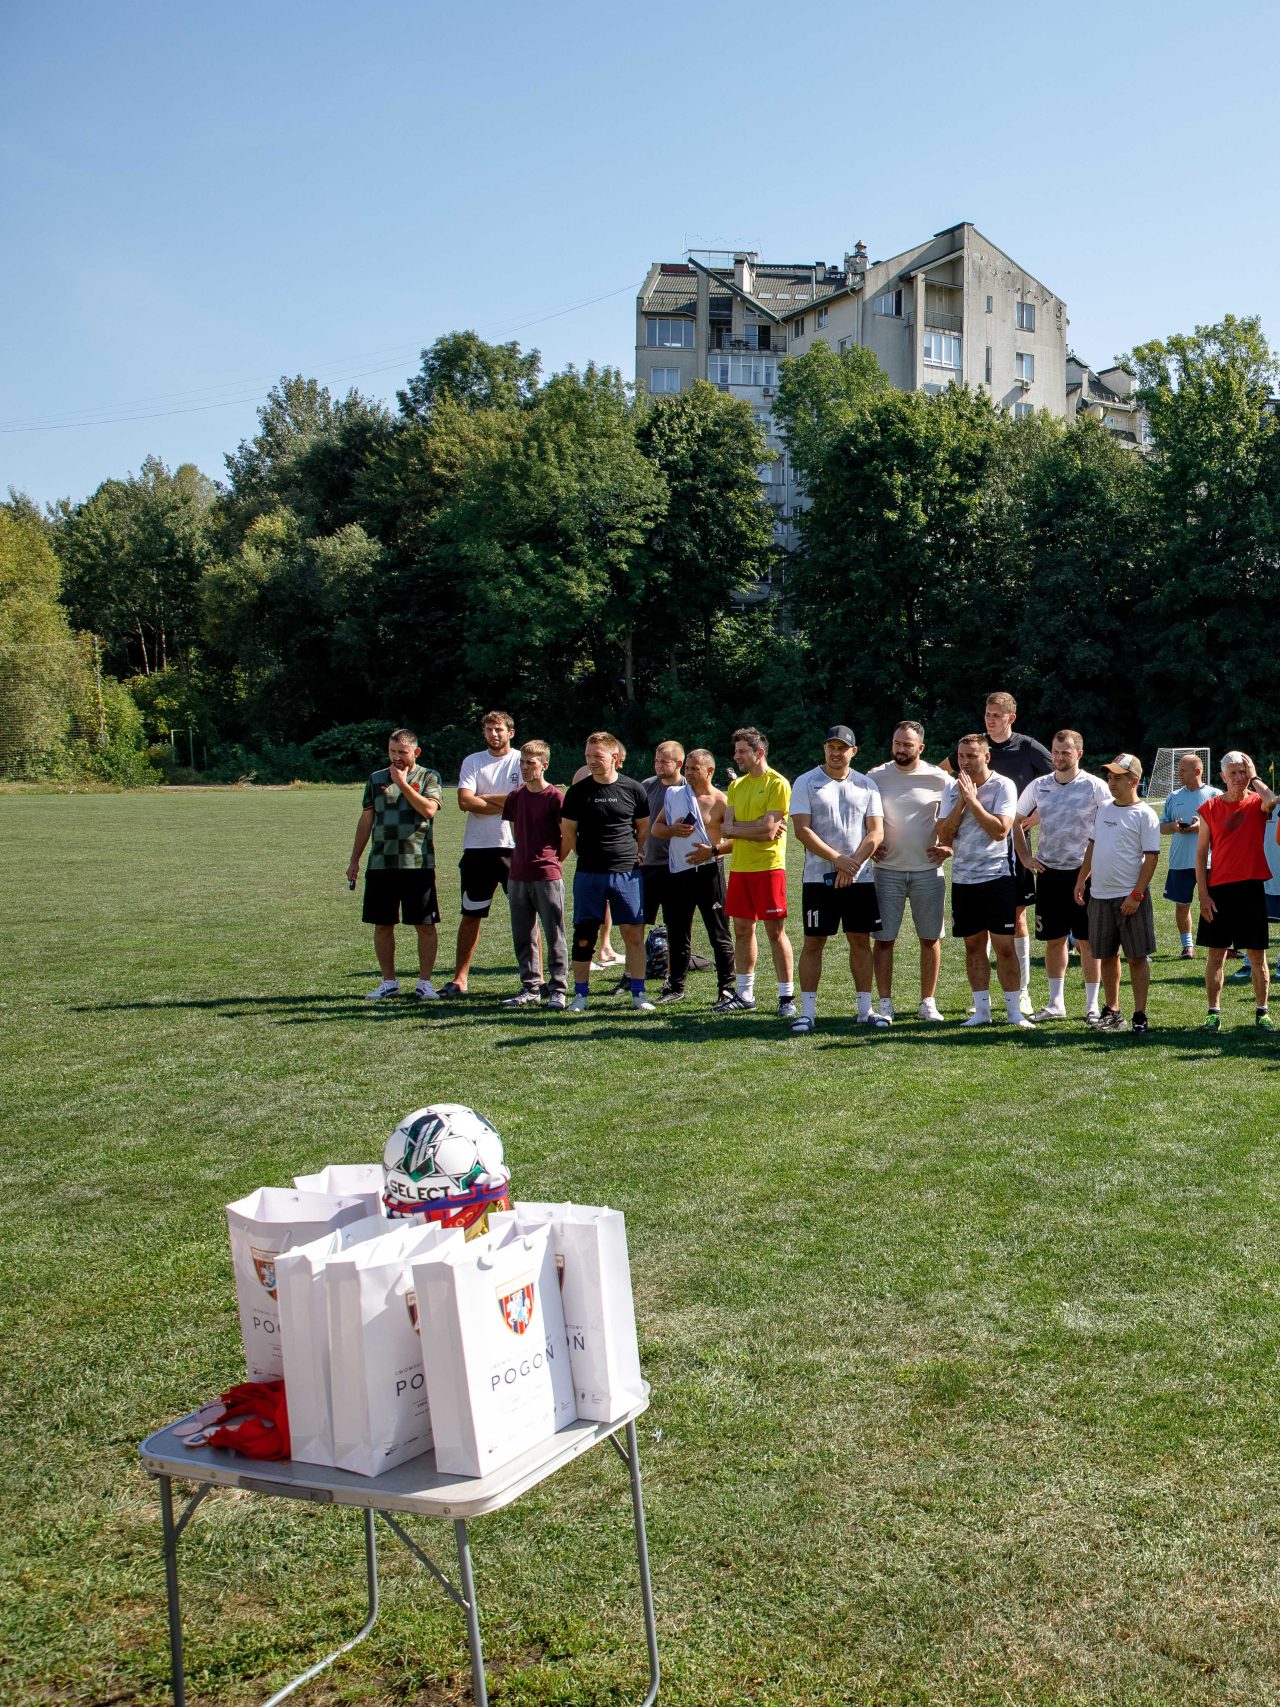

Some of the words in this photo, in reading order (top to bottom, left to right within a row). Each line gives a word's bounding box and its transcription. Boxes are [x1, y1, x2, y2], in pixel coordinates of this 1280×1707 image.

[807, 909, 819, 928] 11
[389, 1179, 450, 1200] SELECT
[491, 1342, 555, 1391] POGOŃ
[396, 1373, 425, 1397] PO
